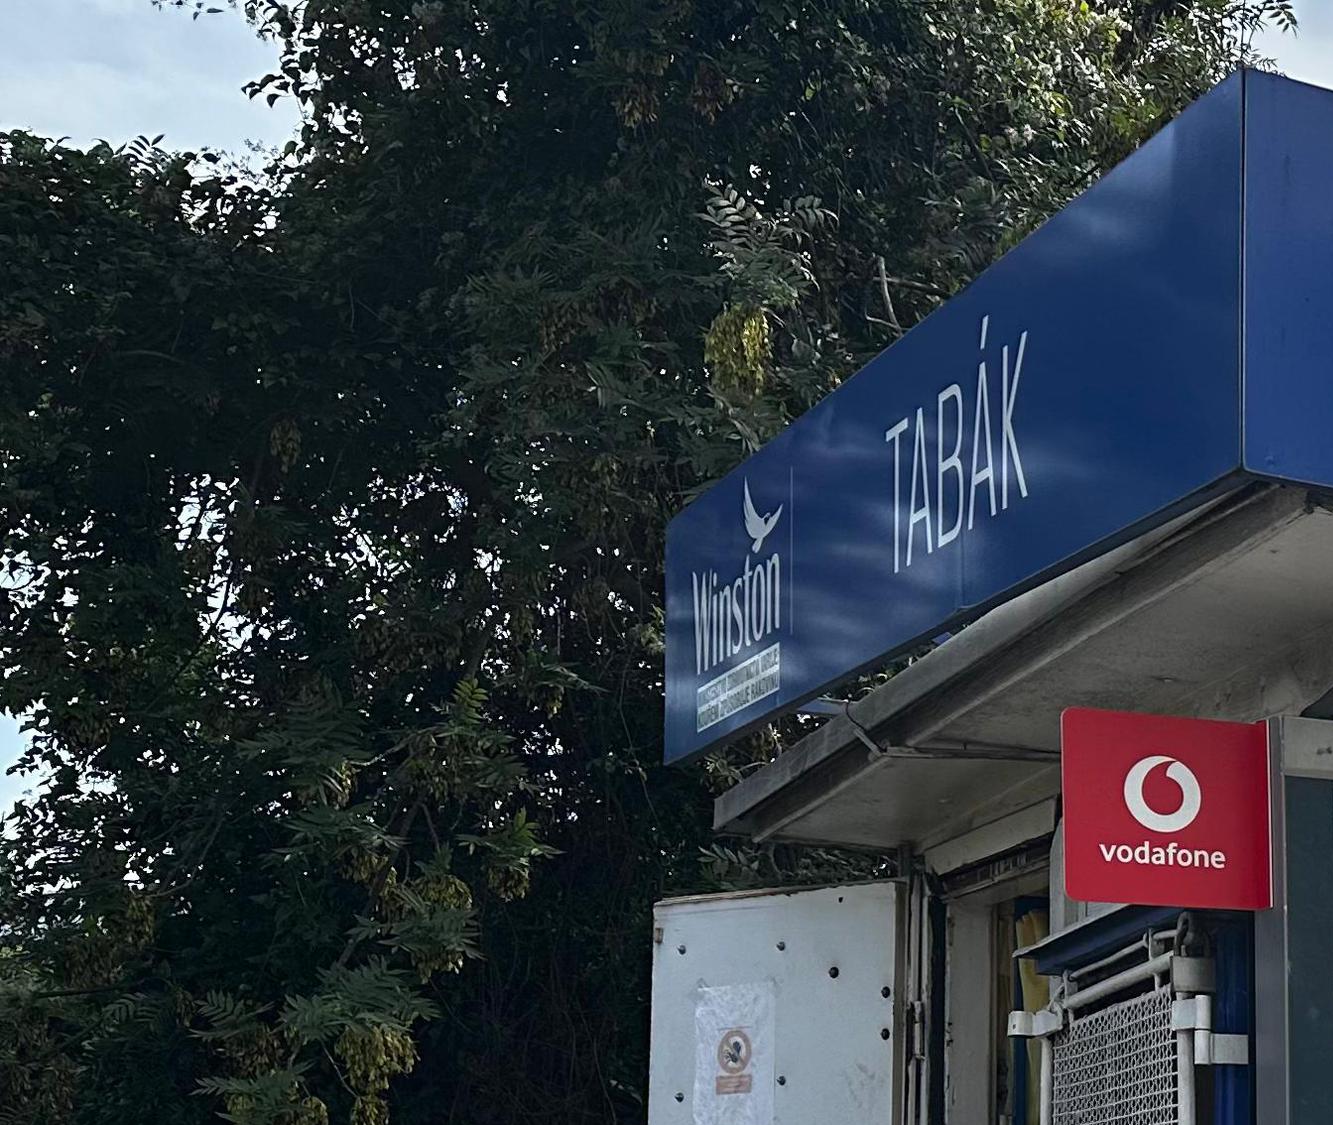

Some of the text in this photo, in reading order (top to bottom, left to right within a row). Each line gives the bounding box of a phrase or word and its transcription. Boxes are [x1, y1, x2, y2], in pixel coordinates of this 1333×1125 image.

[885, 315, 1029, 573] TABÁK
[692, 550, 780, 675] Winston
[1099, 840, 1226, 869] vodafone
